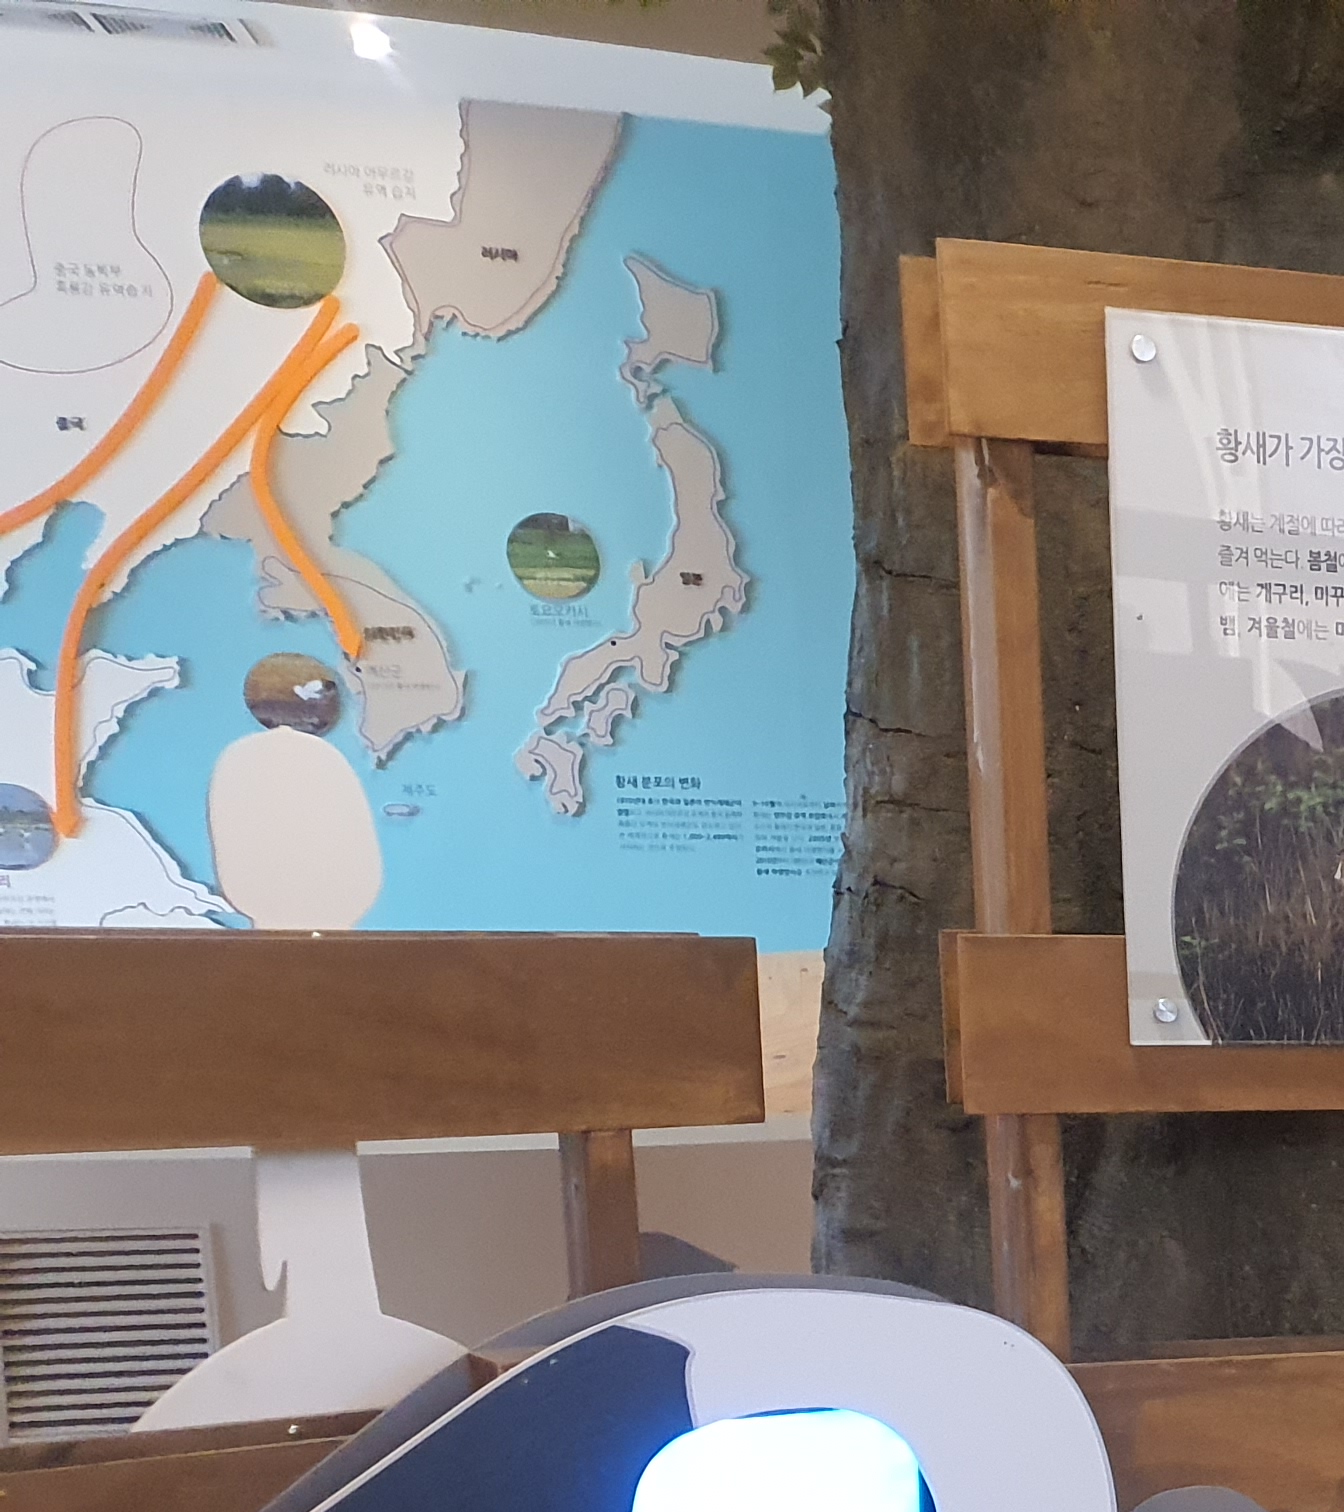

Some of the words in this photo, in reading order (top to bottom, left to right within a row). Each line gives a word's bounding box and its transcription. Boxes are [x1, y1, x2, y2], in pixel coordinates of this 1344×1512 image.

[1215, 427, 1294, 467] 황새가
[1217, 509, 1267, 534] 황새는
[1270, 513, 1317, 537] 계절에
[1218, 544, 1249, 568] 즐겨
[1219, 580, 1251, 603] 에는
[1256, 582, 1310, 607] 개구리,
[1247, 616, 1330, 641] 겨울철에는
[615, 774, 639, 790] 황새
